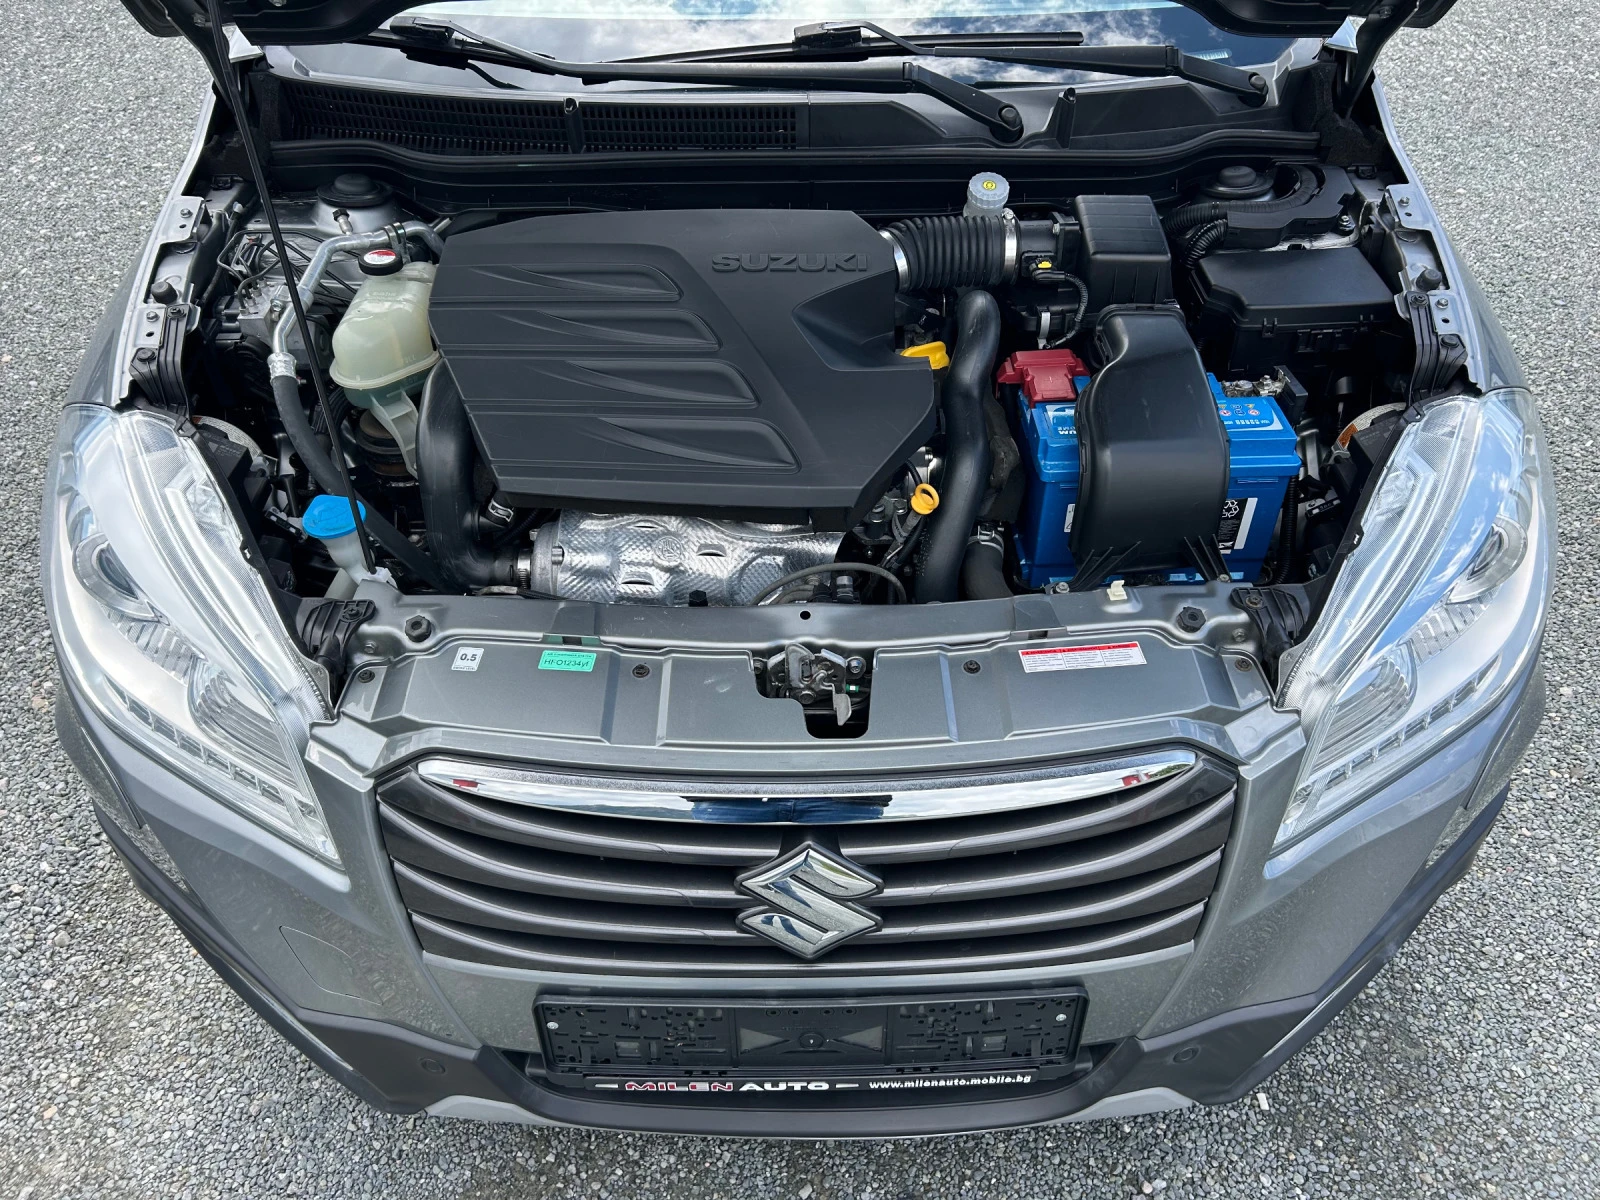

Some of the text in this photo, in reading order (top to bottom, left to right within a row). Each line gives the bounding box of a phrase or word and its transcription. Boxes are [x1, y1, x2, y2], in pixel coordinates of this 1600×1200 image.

[712, 253, 868, 272] SUZUKI
[460, 652, 477, 662] 0.5
[625, 1074, 1032, 1092] MILEN AUTO www.milenauto.mobile.bg
